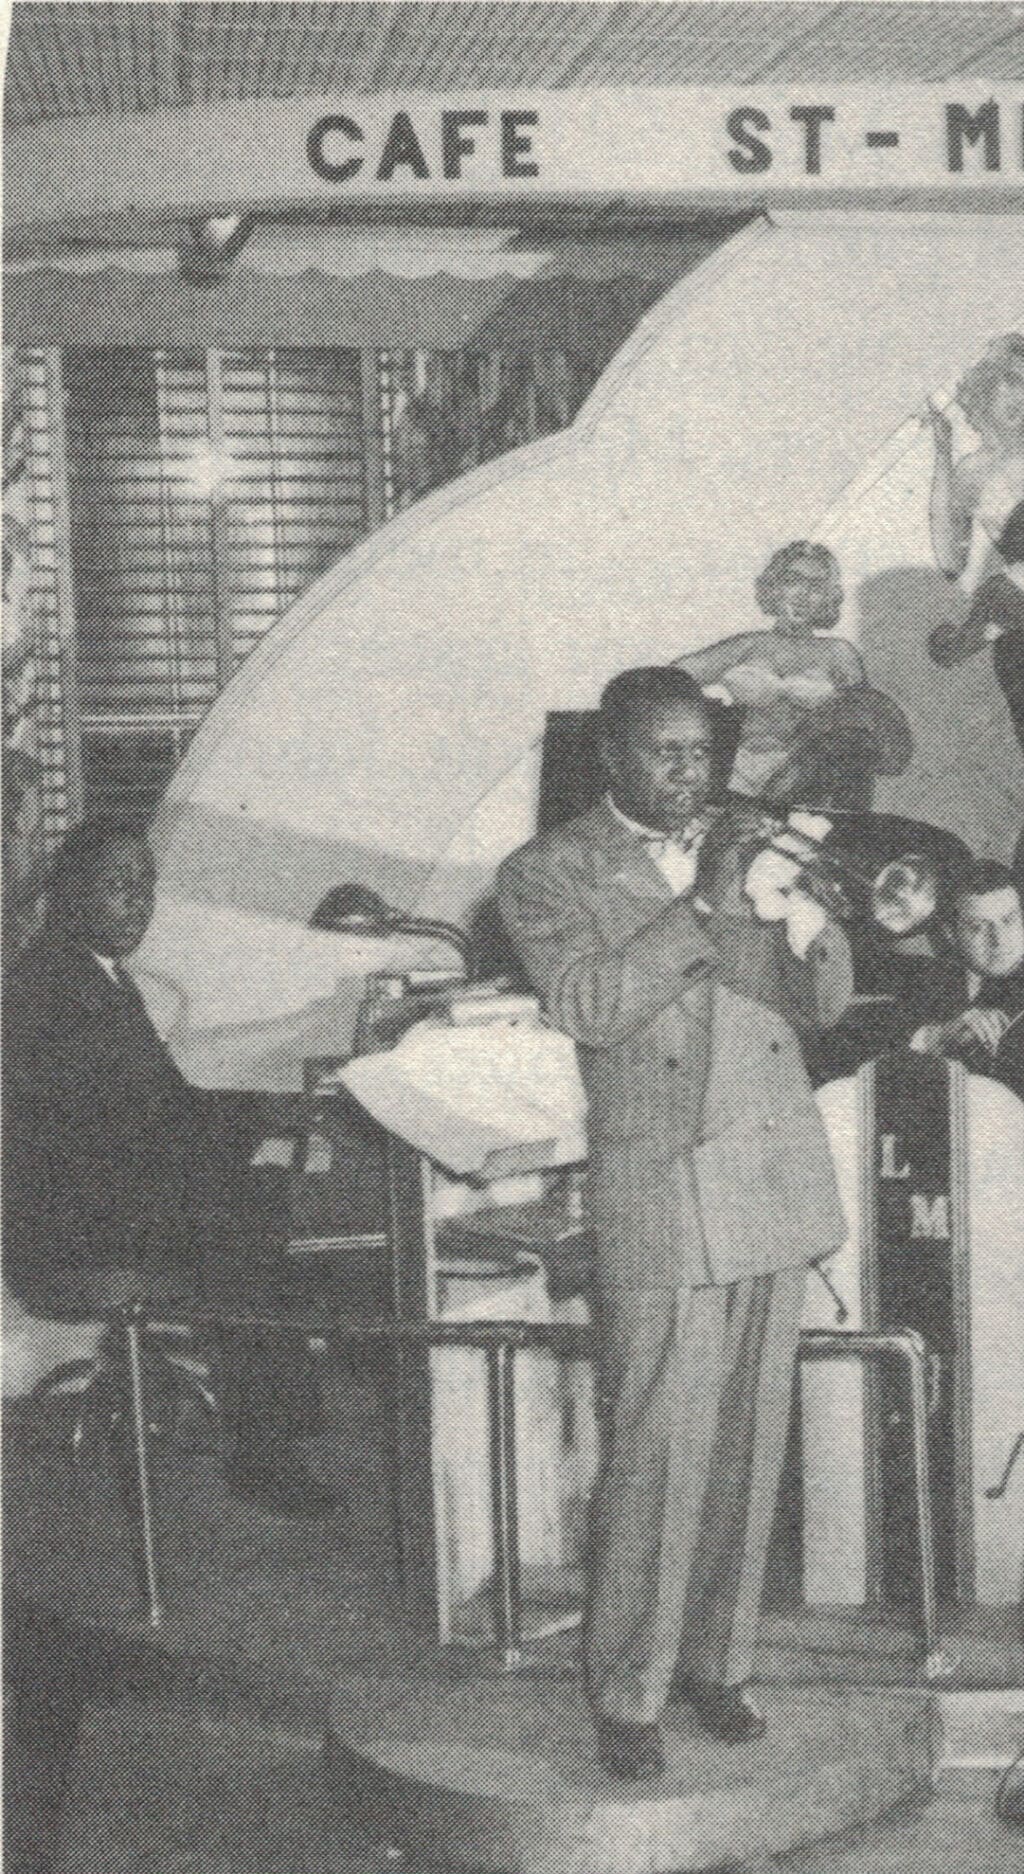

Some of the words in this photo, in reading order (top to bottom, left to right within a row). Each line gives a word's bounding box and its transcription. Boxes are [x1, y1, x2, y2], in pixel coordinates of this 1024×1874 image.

[306, 110, 540, 184] CAFE
[879, 1133, 911, 1179] L
[910, 1194, 950, 1239] M
